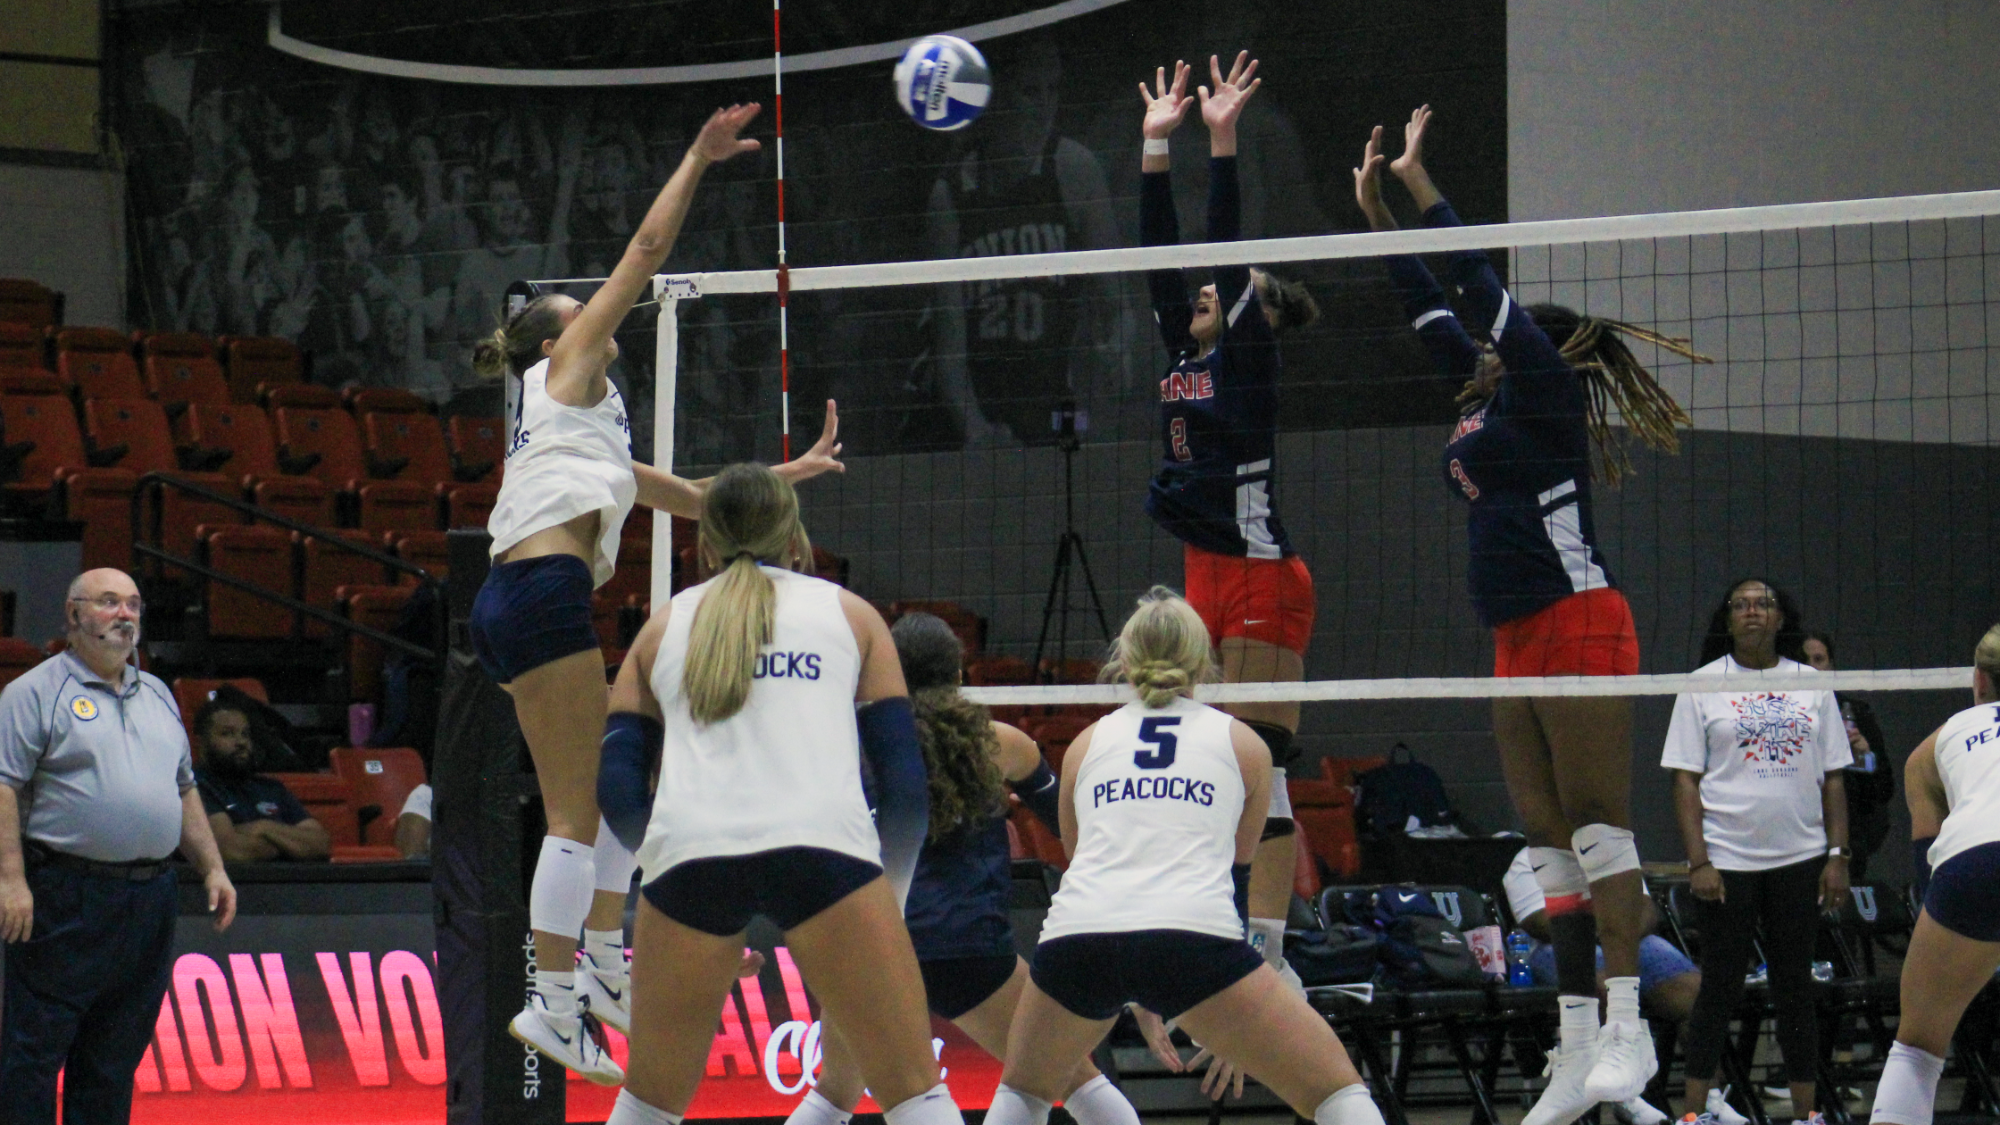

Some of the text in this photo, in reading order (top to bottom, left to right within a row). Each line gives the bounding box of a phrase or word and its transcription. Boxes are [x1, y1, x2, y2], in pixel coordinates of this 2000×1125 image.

[930, 59, 951, 111] molten
[1160, 369, 1214, 402] ANE
[1170, 417, 1193, 461] 2
[1450, 458, 1479, 500] 3
[752, 650, 822, 681] OCKS
[1133, 716, 1182, 769] 5
[1093, 777, 1215, 809] PEACOCKS
